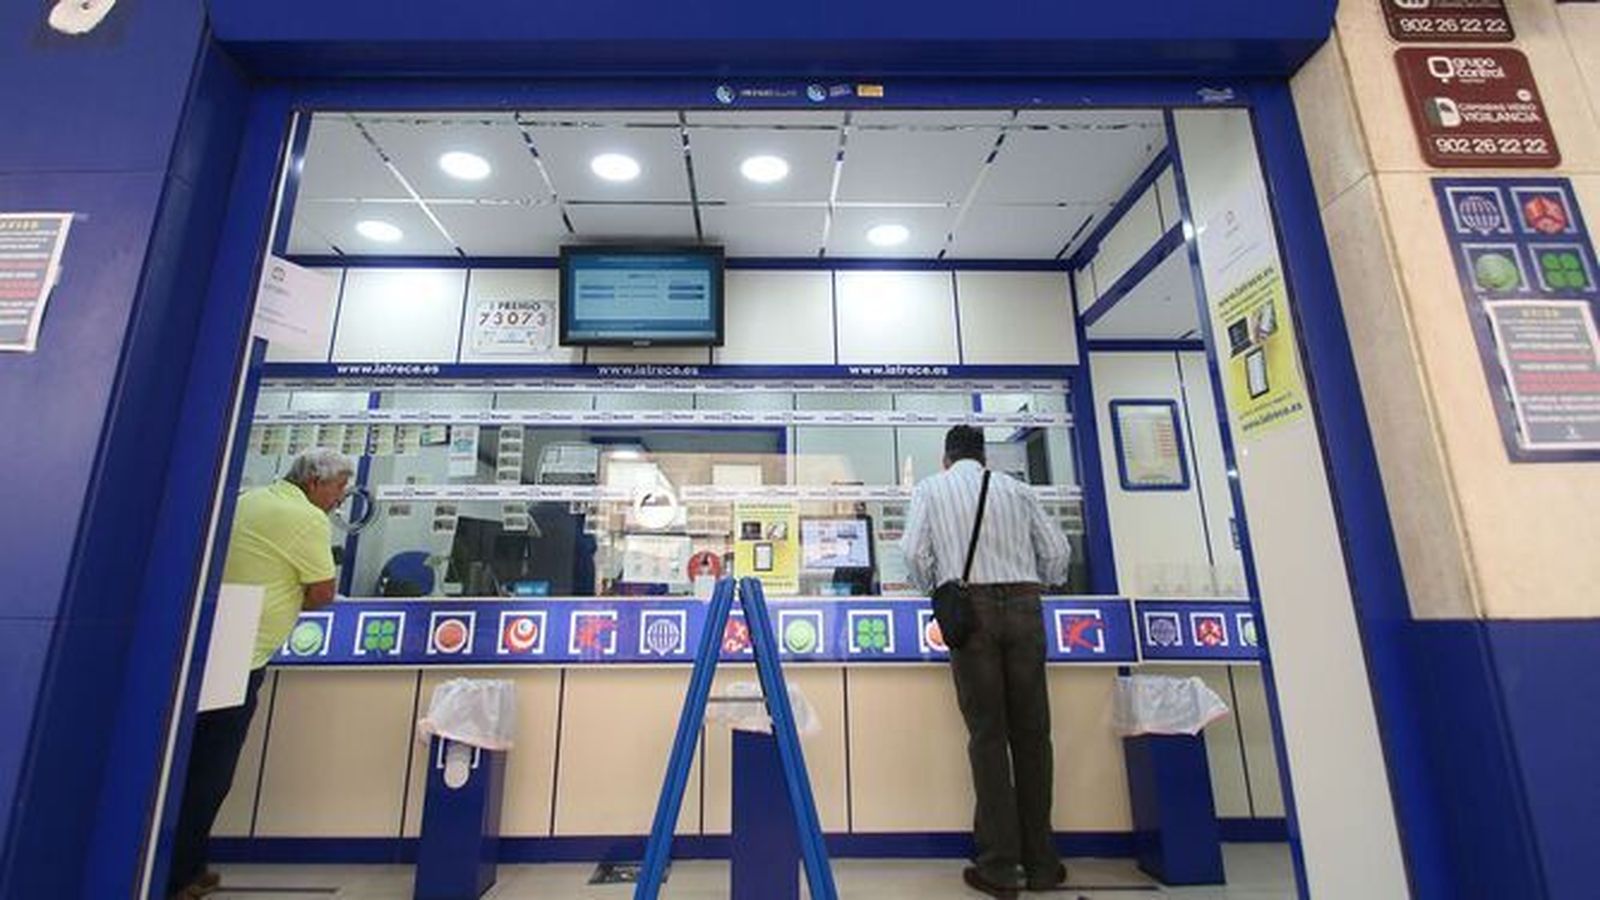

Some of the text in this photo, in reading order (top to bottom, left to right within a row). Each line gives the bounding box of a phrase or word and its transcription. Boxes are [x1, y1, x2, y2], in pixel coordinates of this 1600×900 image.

[1400, 18, 1508, 32] 902 26 22 22
[1452, 57, 1495, 69] grupo
[1456, 66, 1505, 78] control
[1460, 112, 1541, 123] VIGILANCIA
[1436, 138, 1549, 154] 902 26 22 22
[479, 311, 547, 327] 73073
